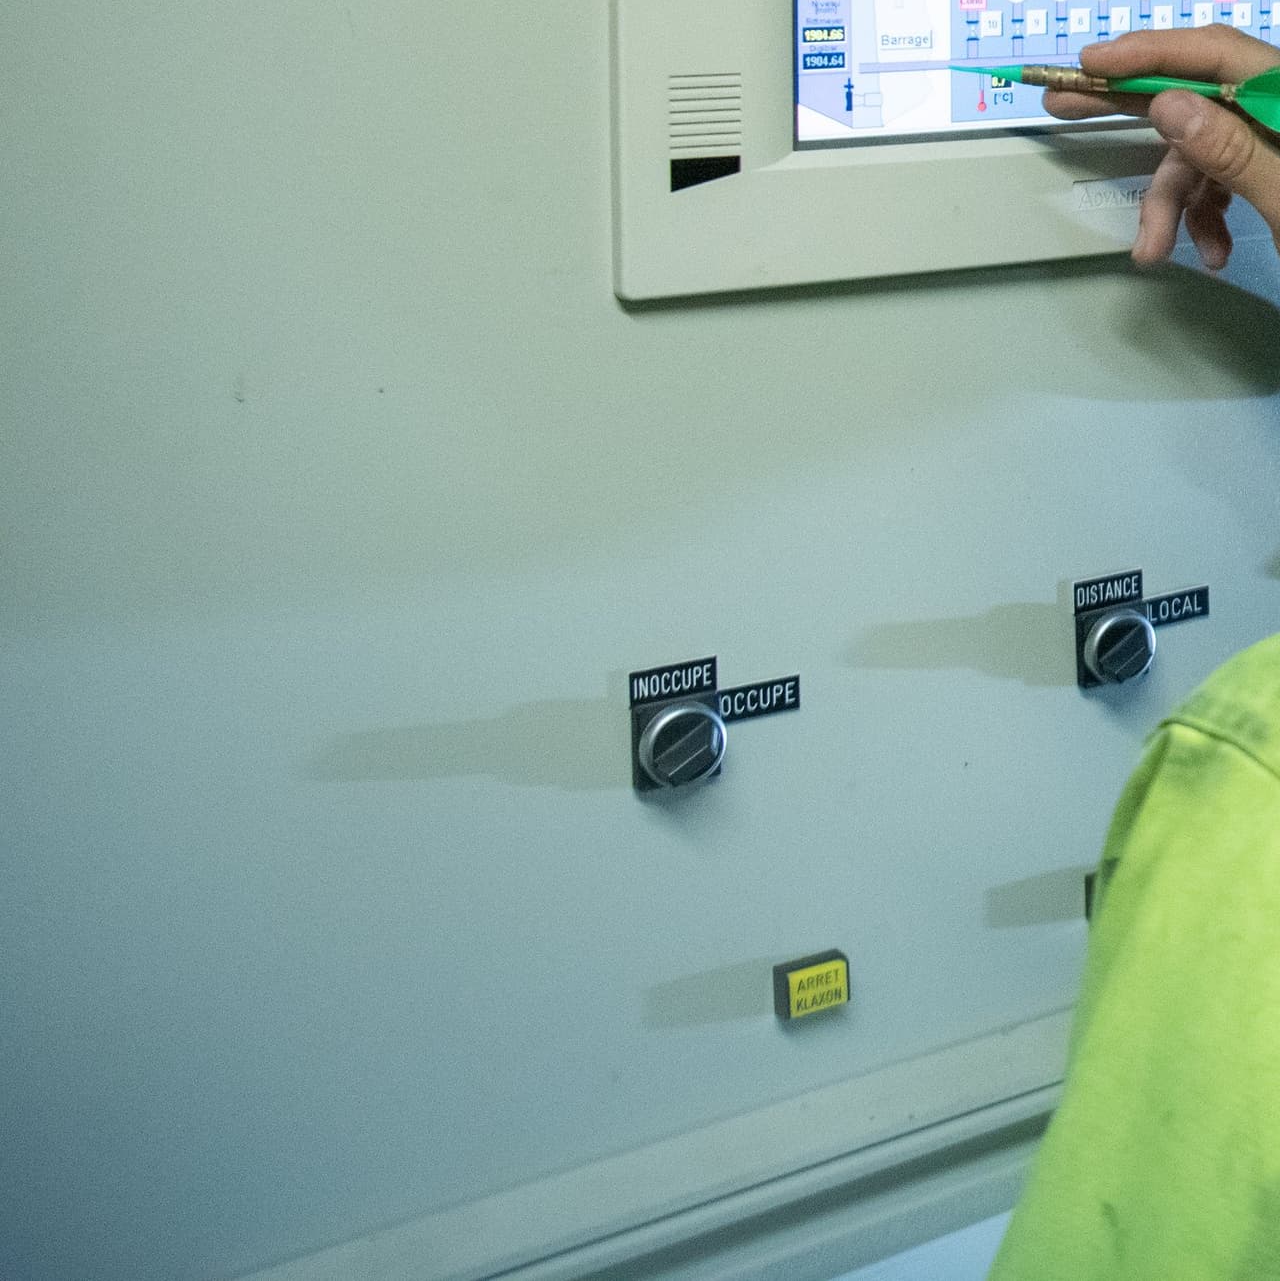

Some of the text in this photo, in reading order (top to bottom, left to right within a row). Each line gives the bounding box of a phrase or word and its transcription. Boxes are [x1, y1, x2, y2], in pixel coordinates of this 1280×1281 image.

[881, 33, 929, 48] Barrage
[805, 54, 844, 68] 1904.64
[1077, 574, 1140, 607] DISTANCE
[1149, 593, 1203, 622] LOCAL
[633, 663, 713, 700] INOCCUPE
[720, 681, 797, 717] OCCUPE
[797, 968, 841, 994] ARRET
[796, 986, 843, 1012] KLAXON
